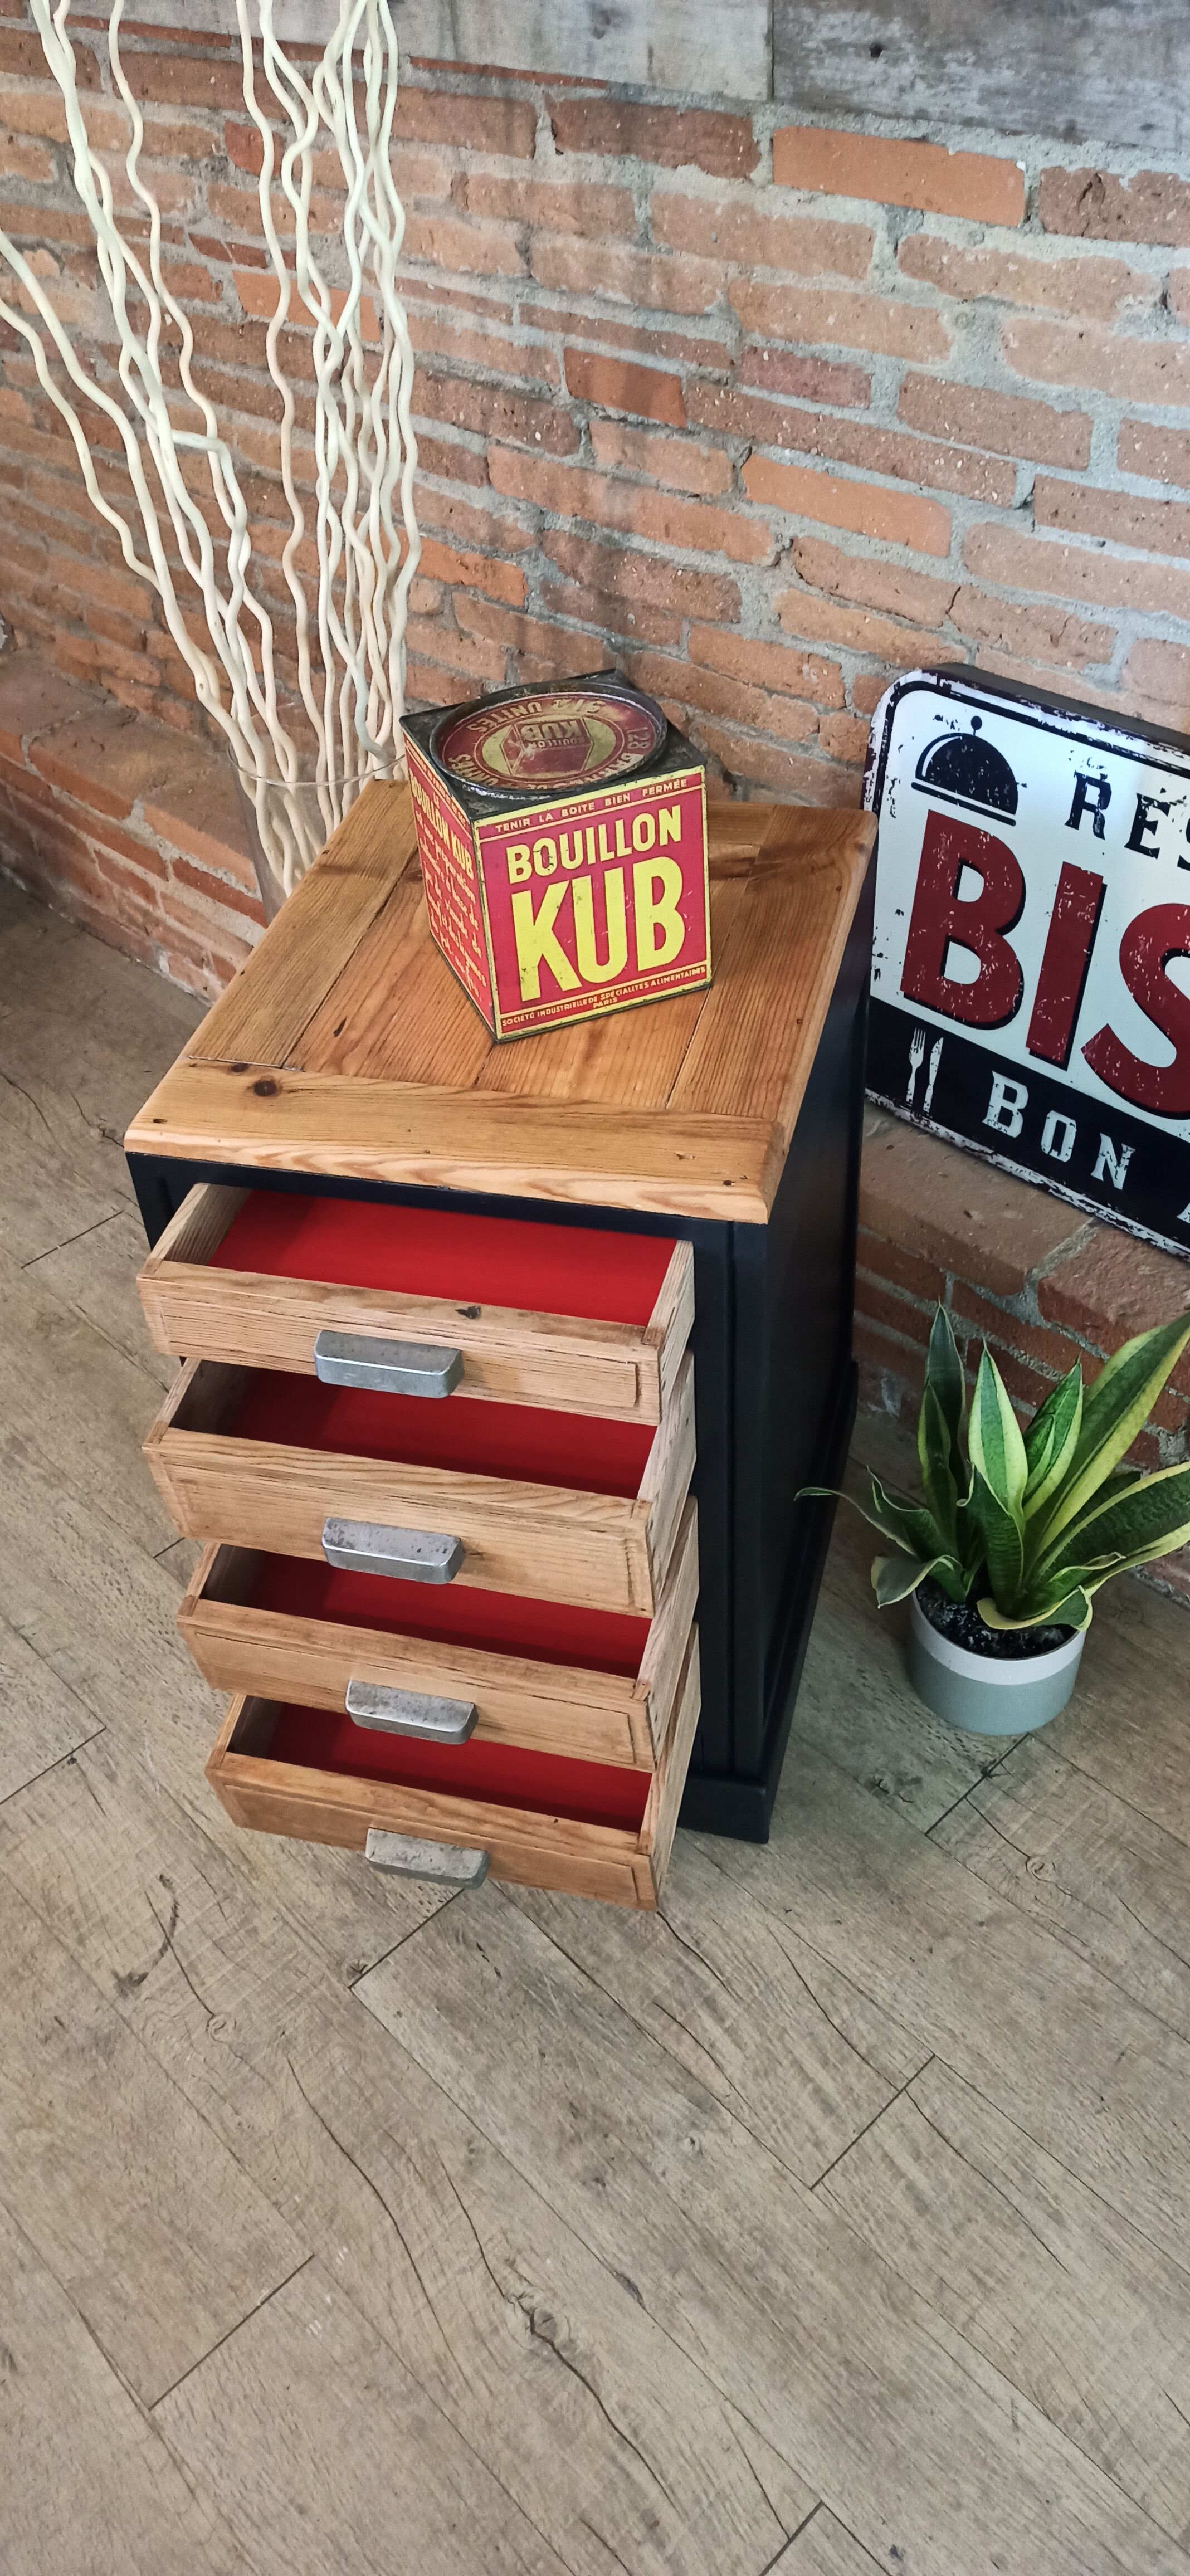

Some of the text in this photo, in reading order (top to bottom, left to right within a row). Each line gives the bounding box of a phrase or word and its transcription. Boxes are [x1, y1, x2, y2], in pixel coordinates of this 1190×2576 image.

[520, 719, 584, 741] KUB
[495, 778, 687, 833] TENIR LA BOITE BIEN FERMÉE
[451, 829, 474, 880] KUB
[506, 805, 681, 884] BOUILLON
[511, 856, 685, 1002] KUB
[537, 999, 588, 1018] INDUSTRIELLE
[588, 996, 598, 1004] DE
[650, 966, 706, 987] ALIMENTAIRES
[593, 997, 618, 1009] PARIS
[982, 1070, 1136, 1191] BON
